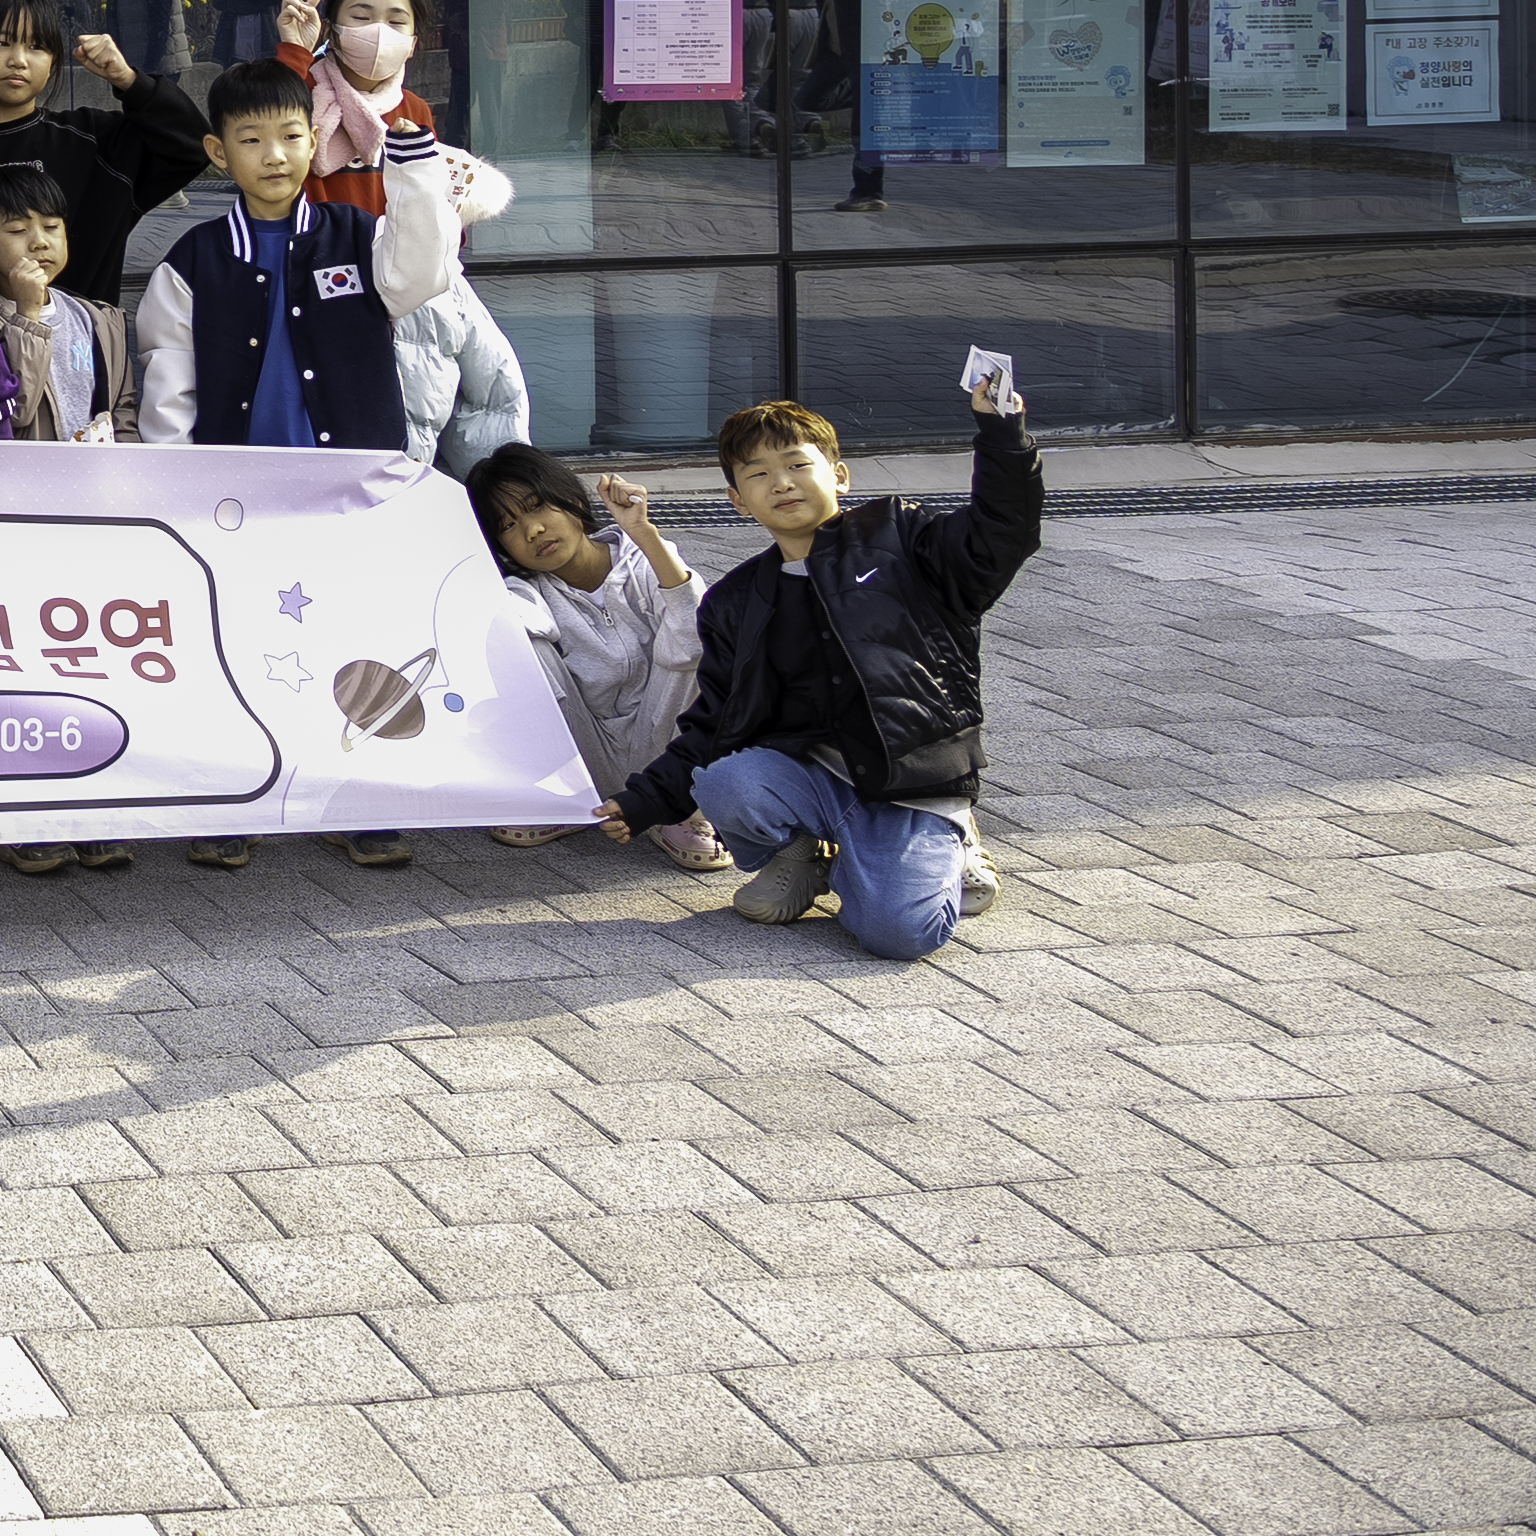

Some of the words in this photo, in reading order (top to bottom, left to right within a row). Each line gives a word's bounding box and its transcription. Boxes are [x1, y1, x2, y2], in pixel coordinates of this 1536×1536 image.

[1407, 38, 1427, 49] 고장
[1419, 60, 1473, 74] 청양사랑의
[1419, 75, 1474, 89] 실천입니다
[40, 597, 177, 684] 운영
